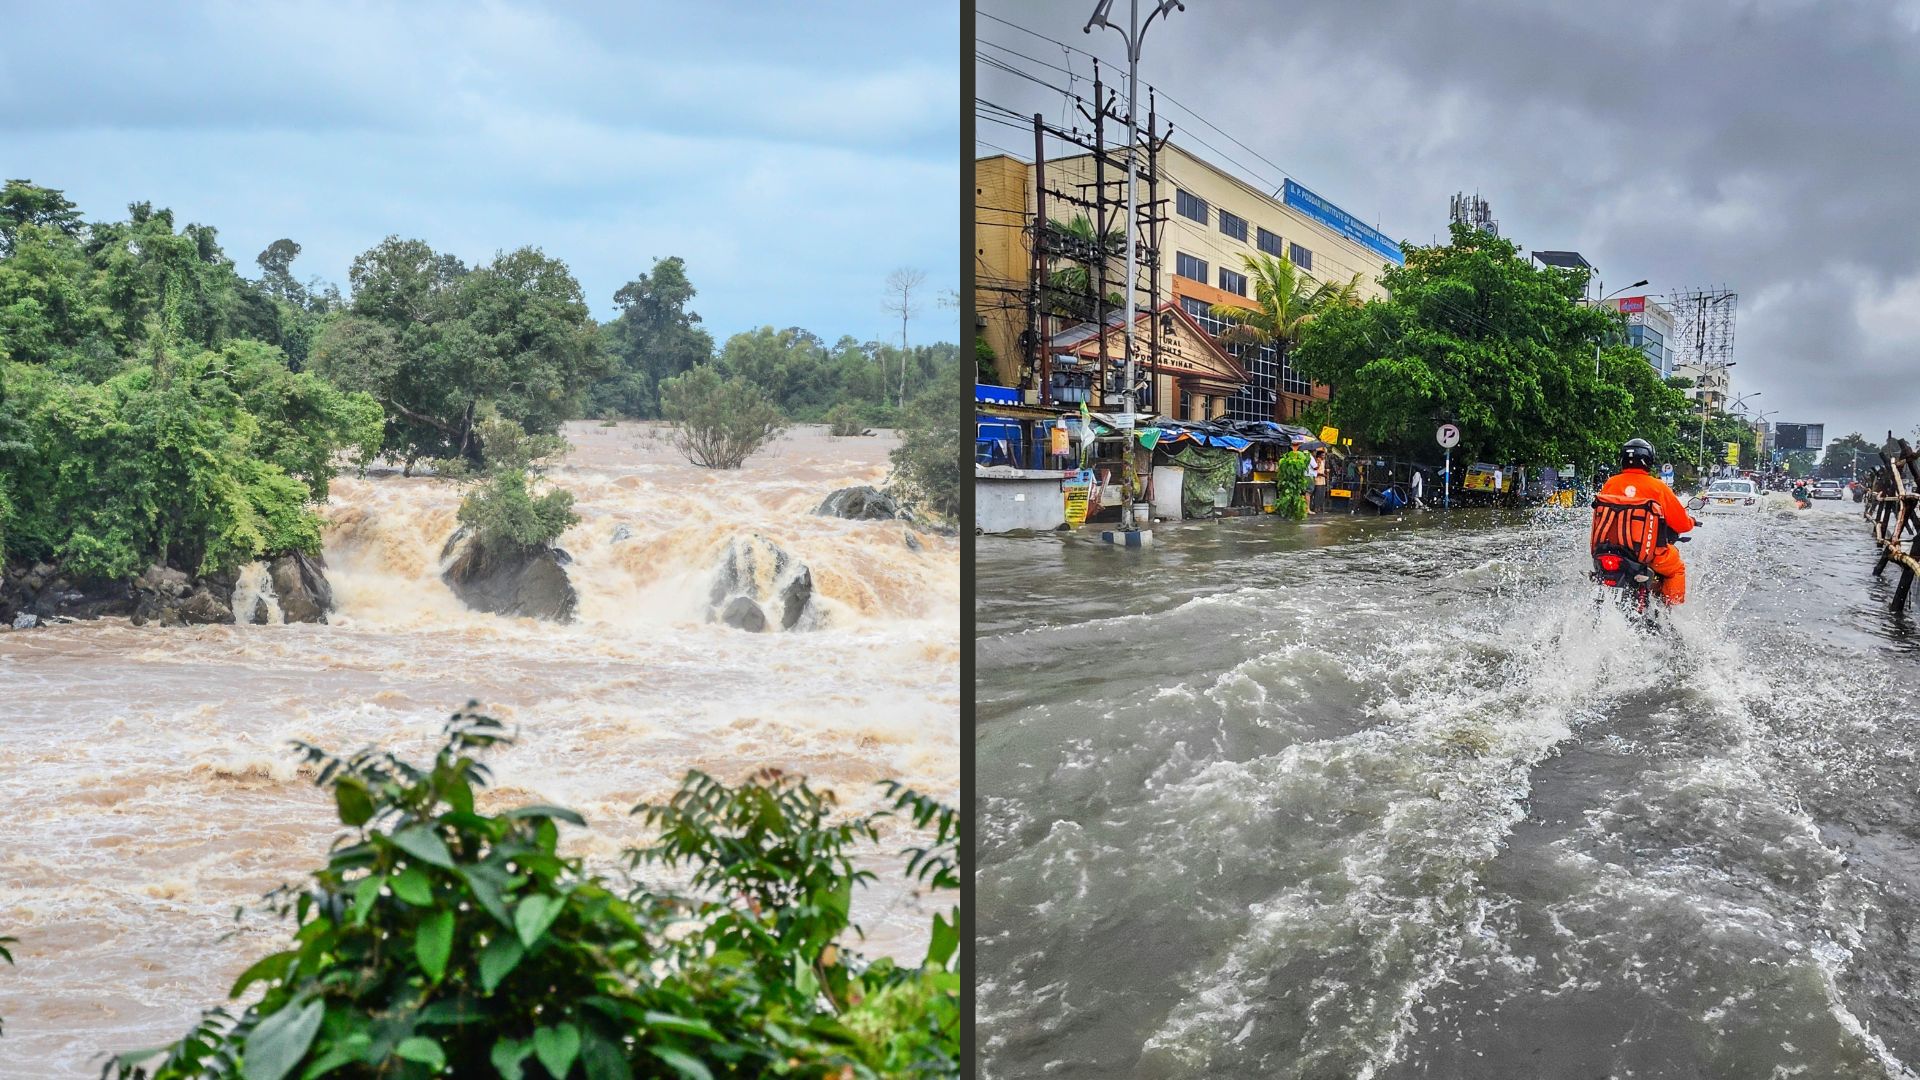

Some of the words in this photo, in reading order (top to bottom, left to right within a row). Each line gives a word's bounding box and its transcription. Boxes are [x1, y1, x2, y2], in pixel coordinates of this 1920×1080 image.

[1301, 190, 1320, 208] PODDAR
[1135, 353, 1168, 364] PODAR
[1171, 359, 1193, 369] VIHAR
